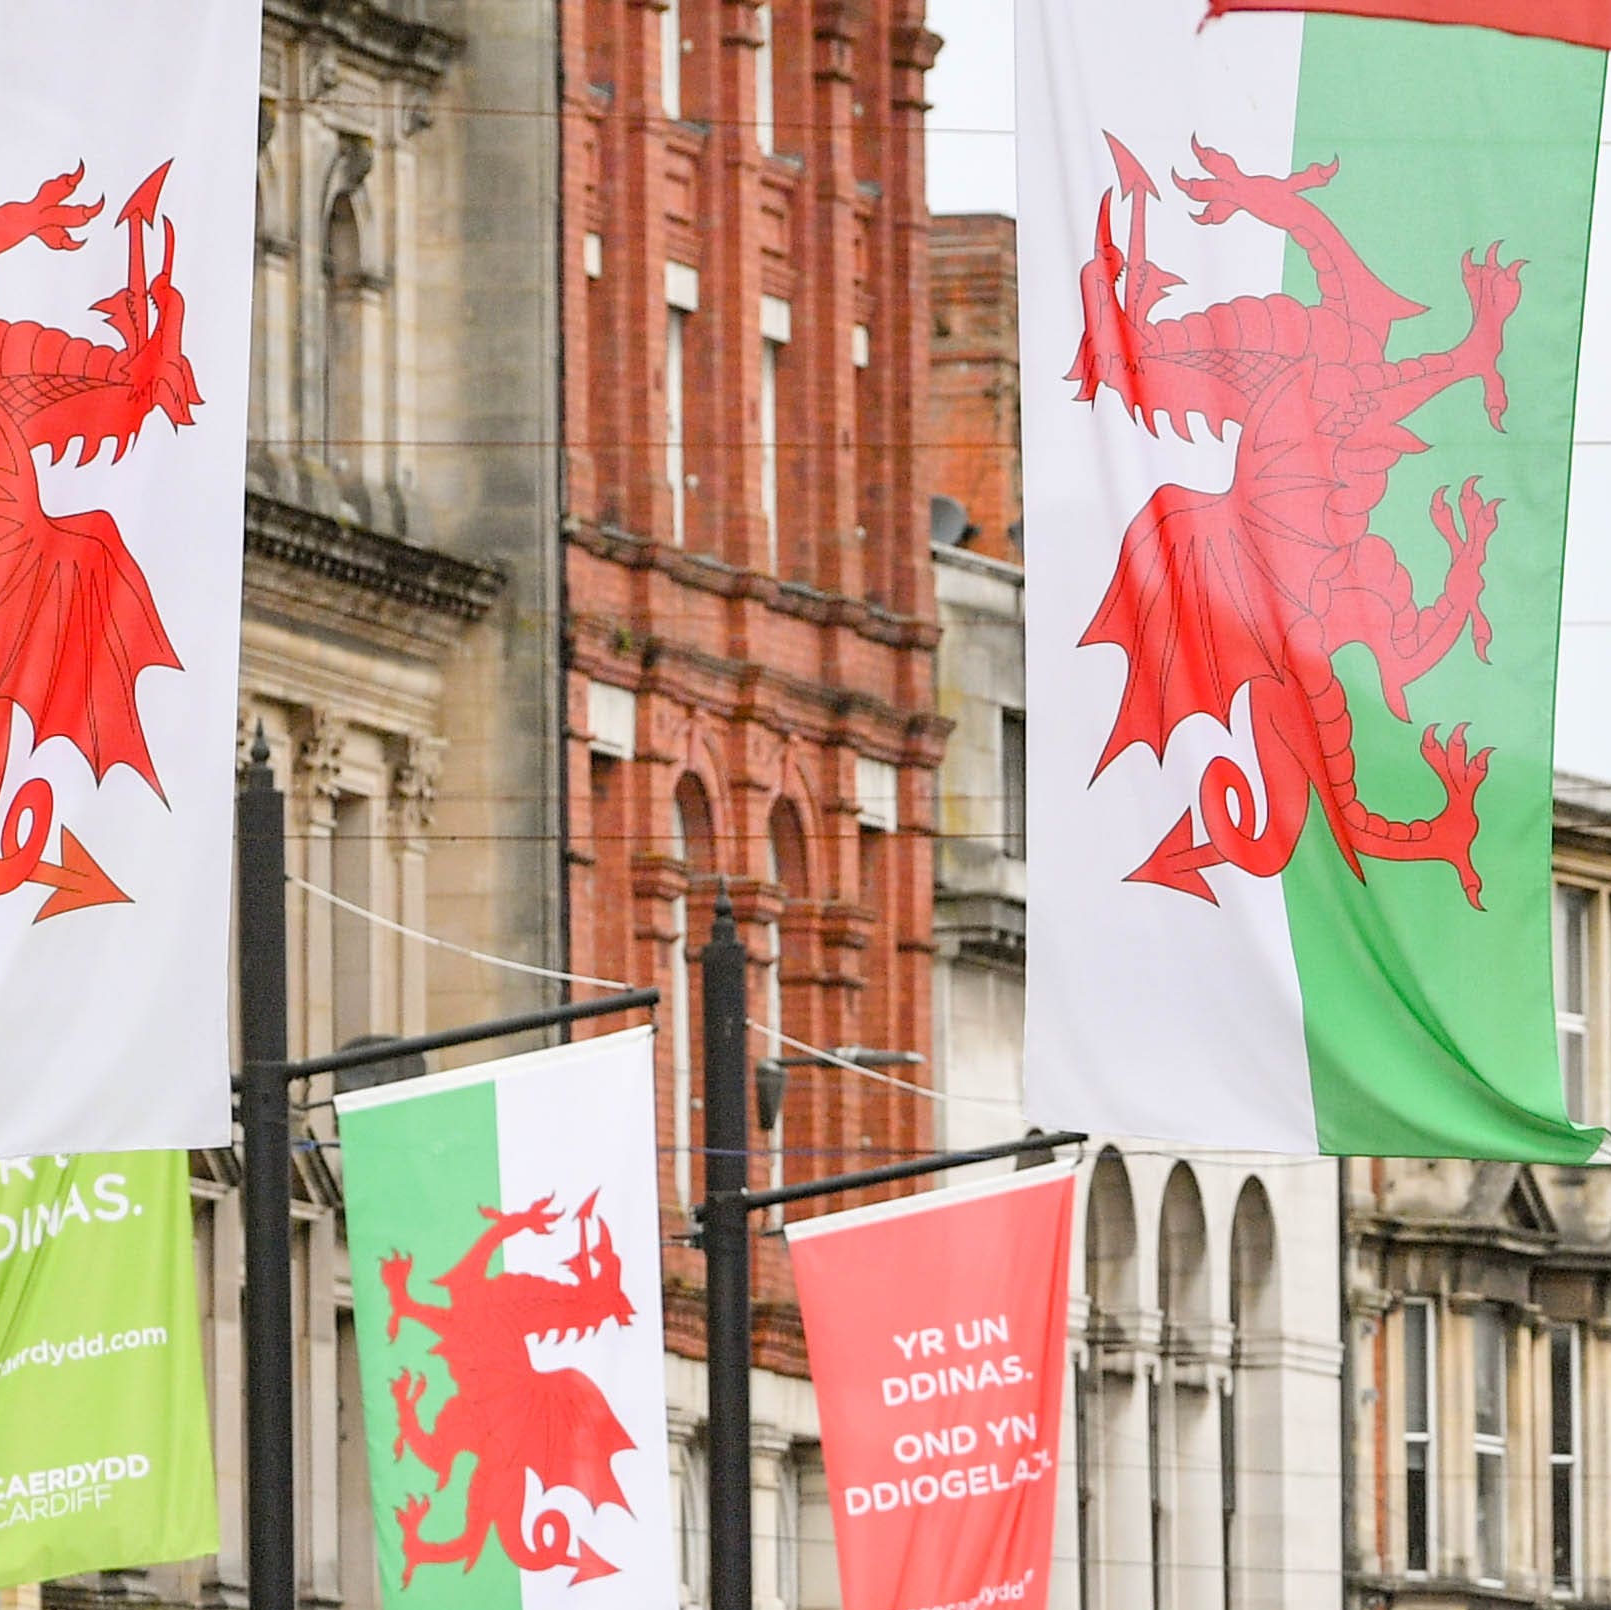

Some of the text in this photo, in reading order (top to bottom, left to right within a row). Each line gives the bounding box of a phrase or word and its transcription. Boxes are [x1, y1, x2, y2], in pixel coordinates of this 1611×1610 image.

[893, 1313, 1009, 1361] YR UN
[881, 1355, 1034, 1407] DDINAS.
[893, 1412, 1037, 1464] OND YN
